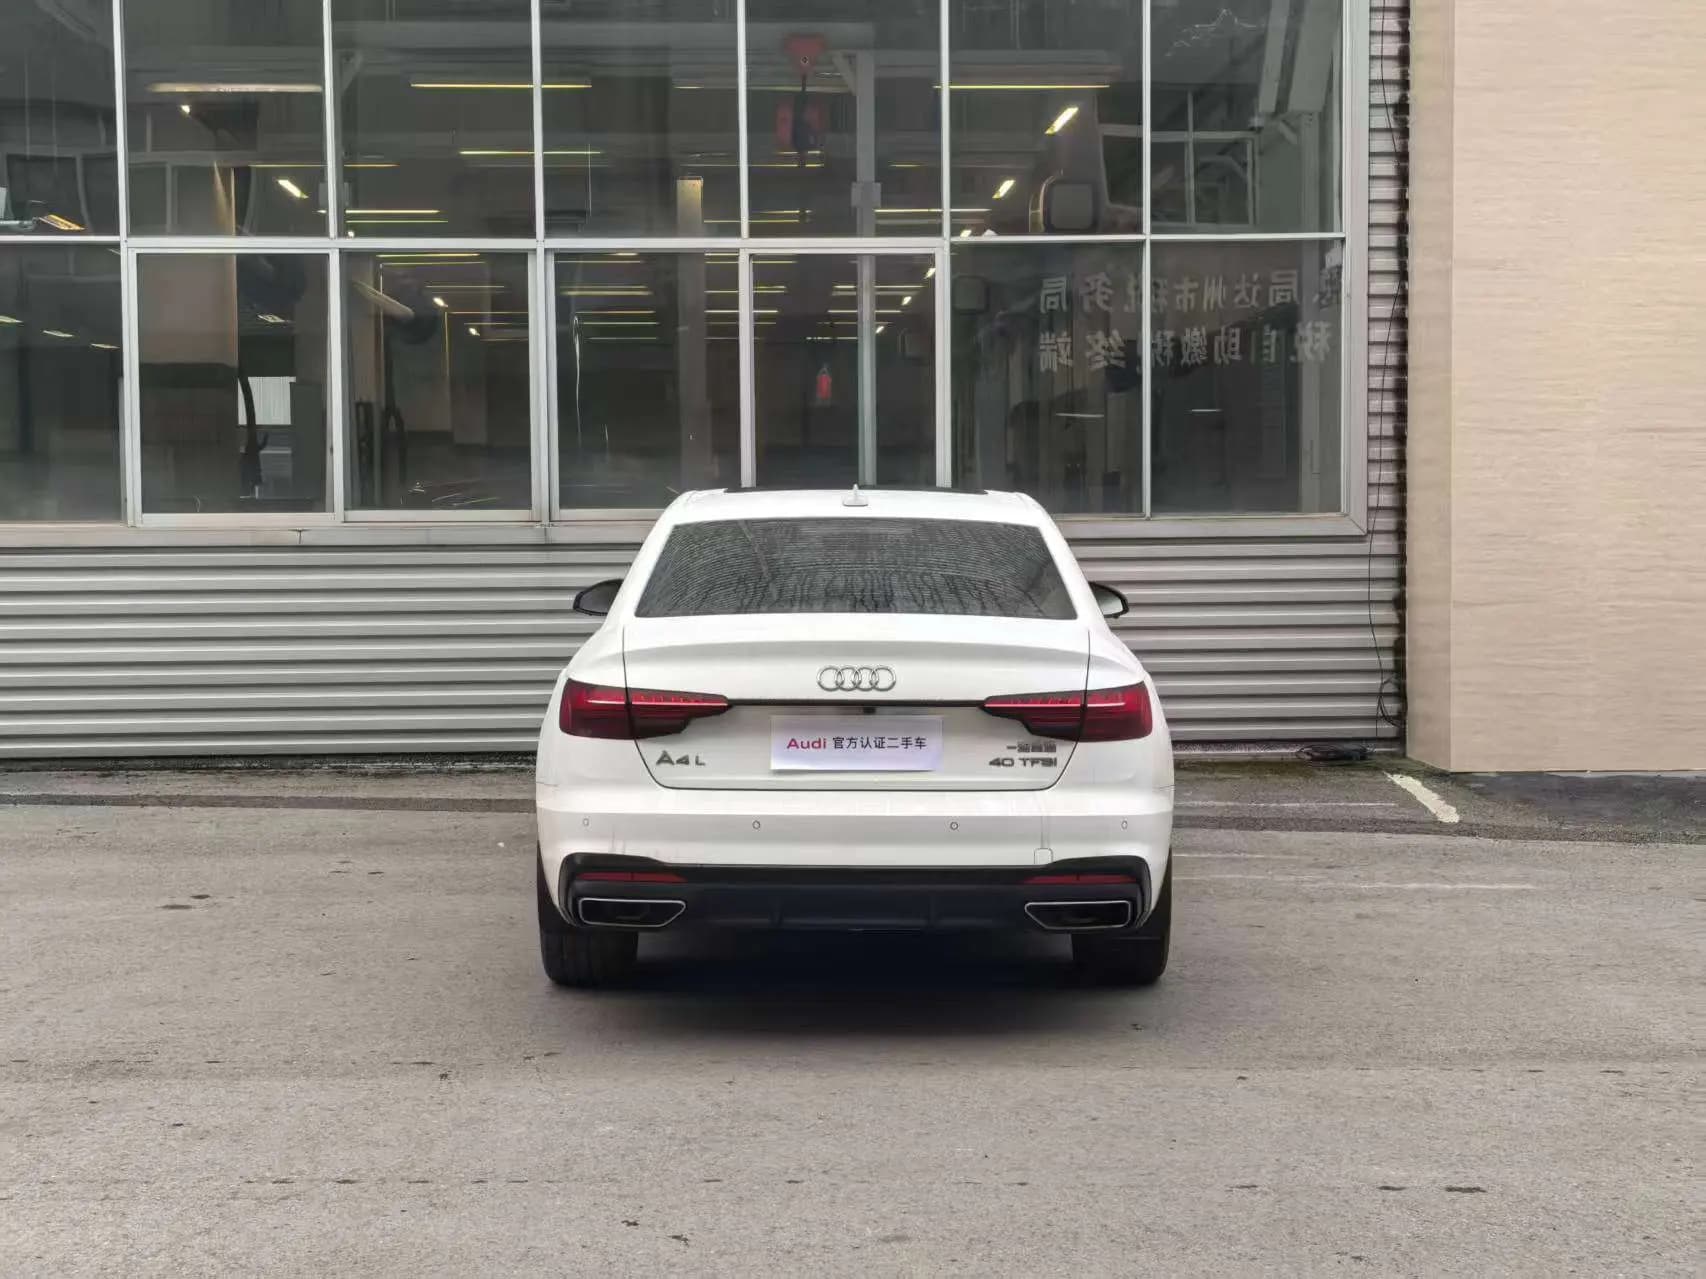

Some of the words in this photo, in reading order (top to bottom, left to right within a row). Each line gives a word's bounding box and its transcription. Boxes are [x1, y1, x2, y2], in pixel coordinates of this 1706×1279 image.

[786, 737, 828, 750] Audi
[832, 736, 928, 750] 官方认证二手车
[988, 757, 1015, 768] 40
